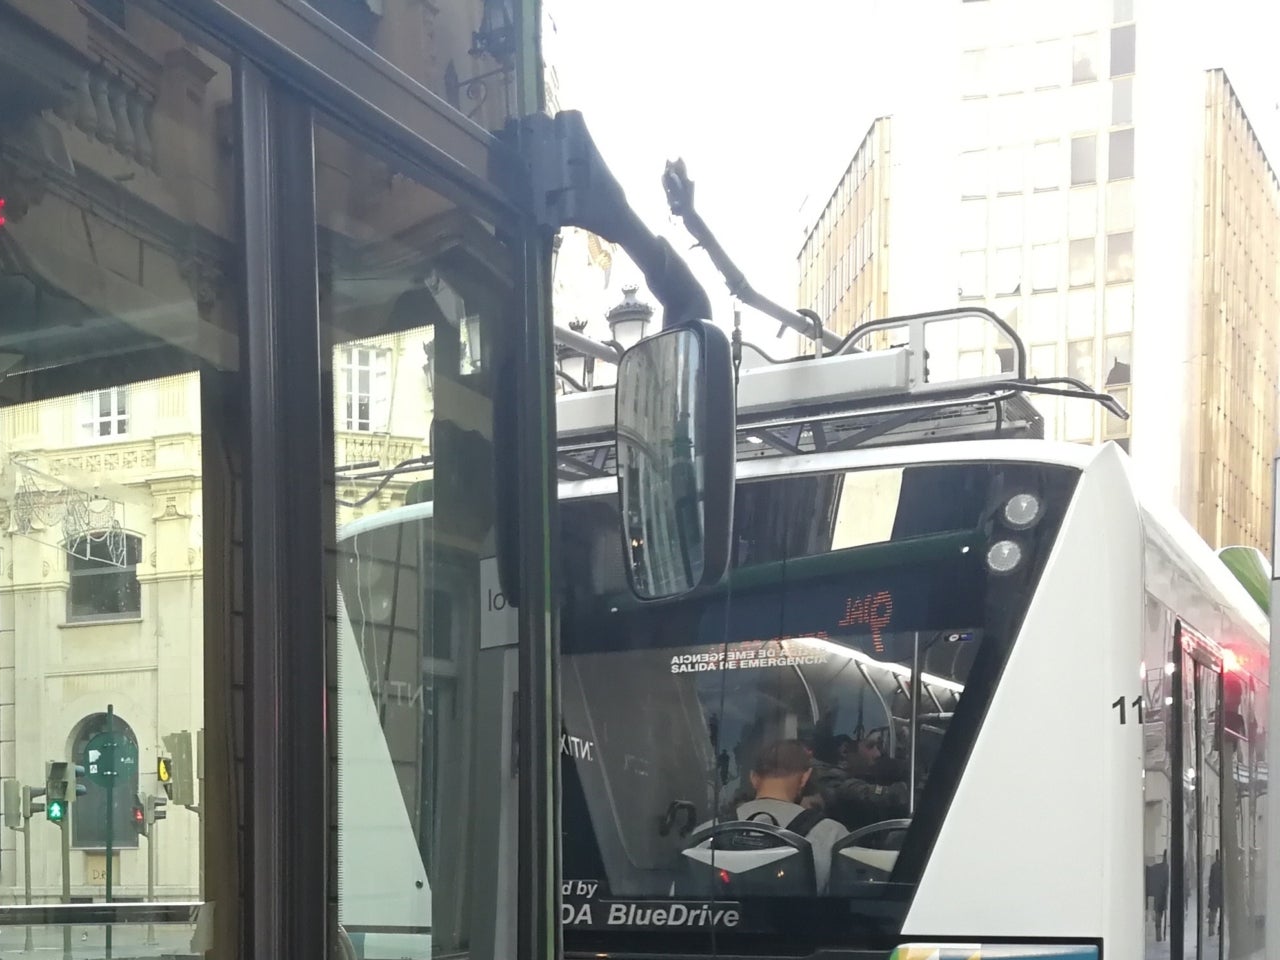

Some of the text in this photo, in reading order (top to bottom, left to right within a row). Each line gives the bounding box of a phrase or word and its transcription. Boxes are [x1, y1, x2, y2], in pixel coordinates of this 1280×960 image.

[671, 656, 828, 674] SALIDA DE EMERGENCIA
[576, 880, 598, 898] by
[607, 904, 740, 927] BlueDrive
